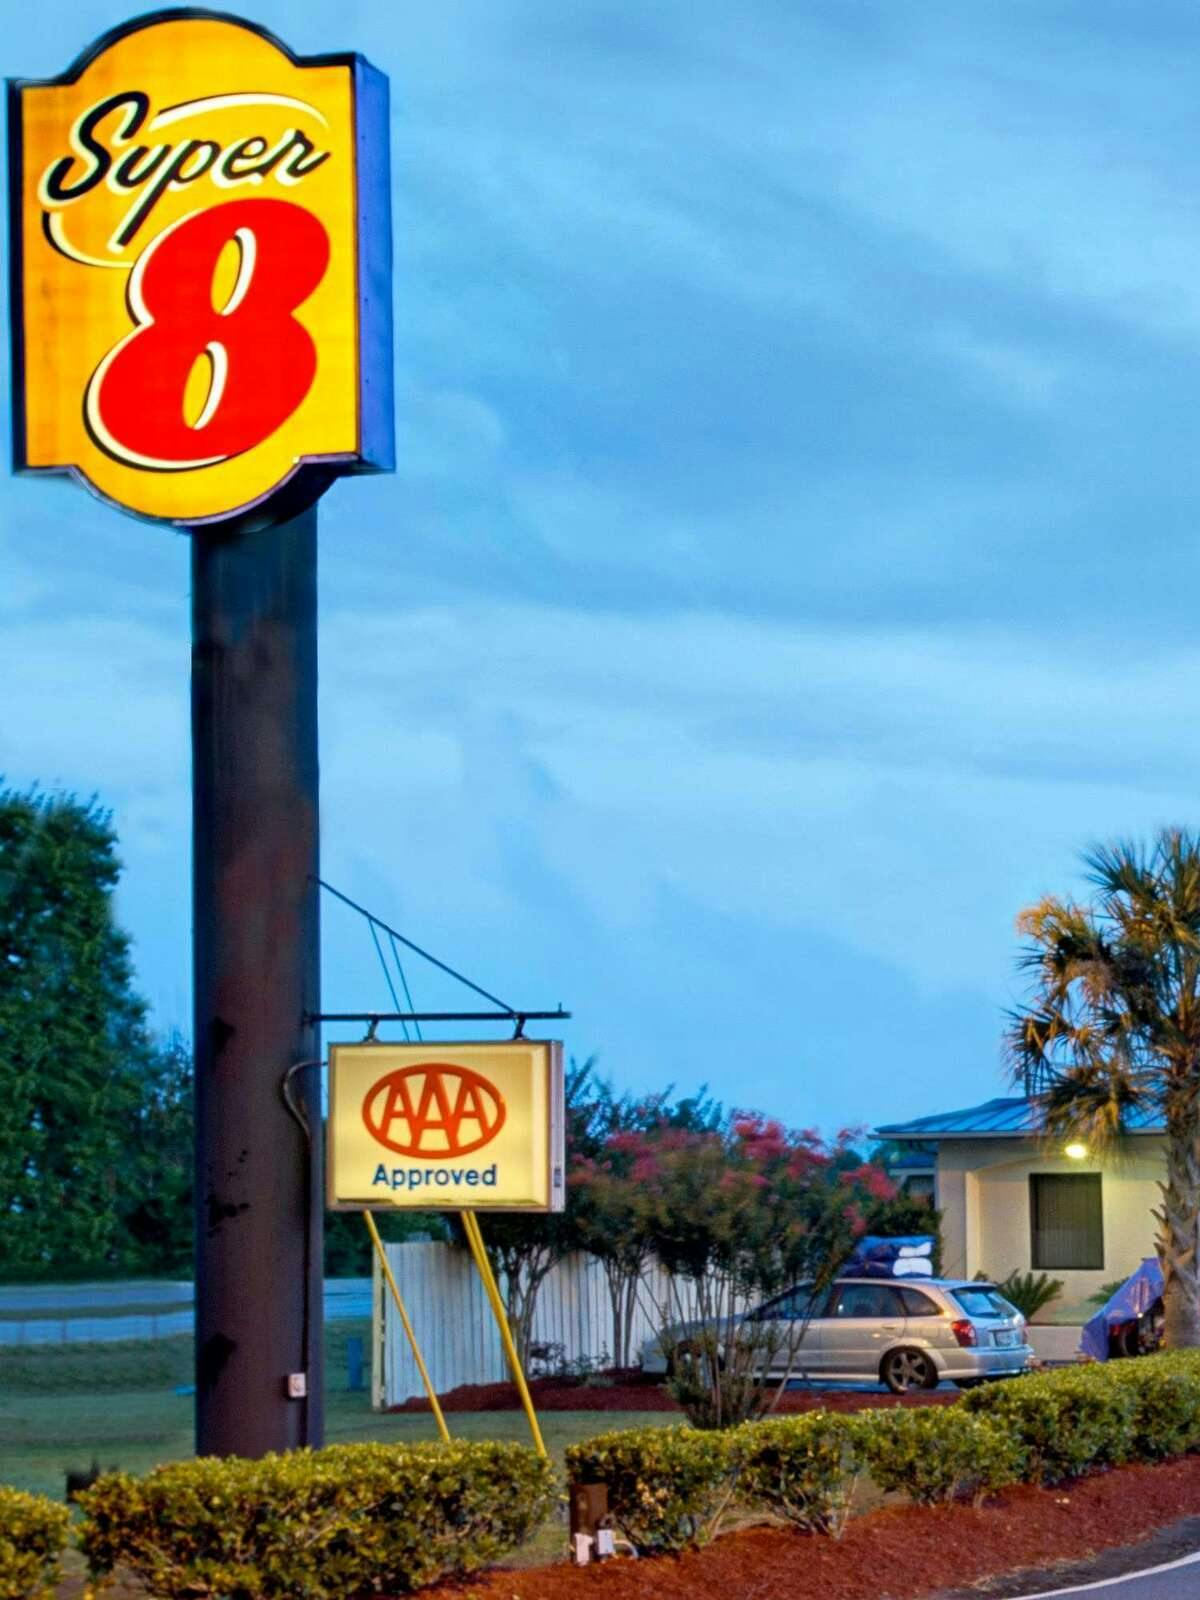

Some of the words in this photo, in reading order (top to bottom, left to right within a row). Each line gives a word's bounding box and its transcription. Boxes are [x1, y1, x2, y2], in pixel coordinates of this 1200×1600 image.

[40, 91, 330, 253] Super
[83, 197, 331, 473] 8
[376, 1065, 496, 1157] AAA
[372, 1164, 497, 1190] Approved
